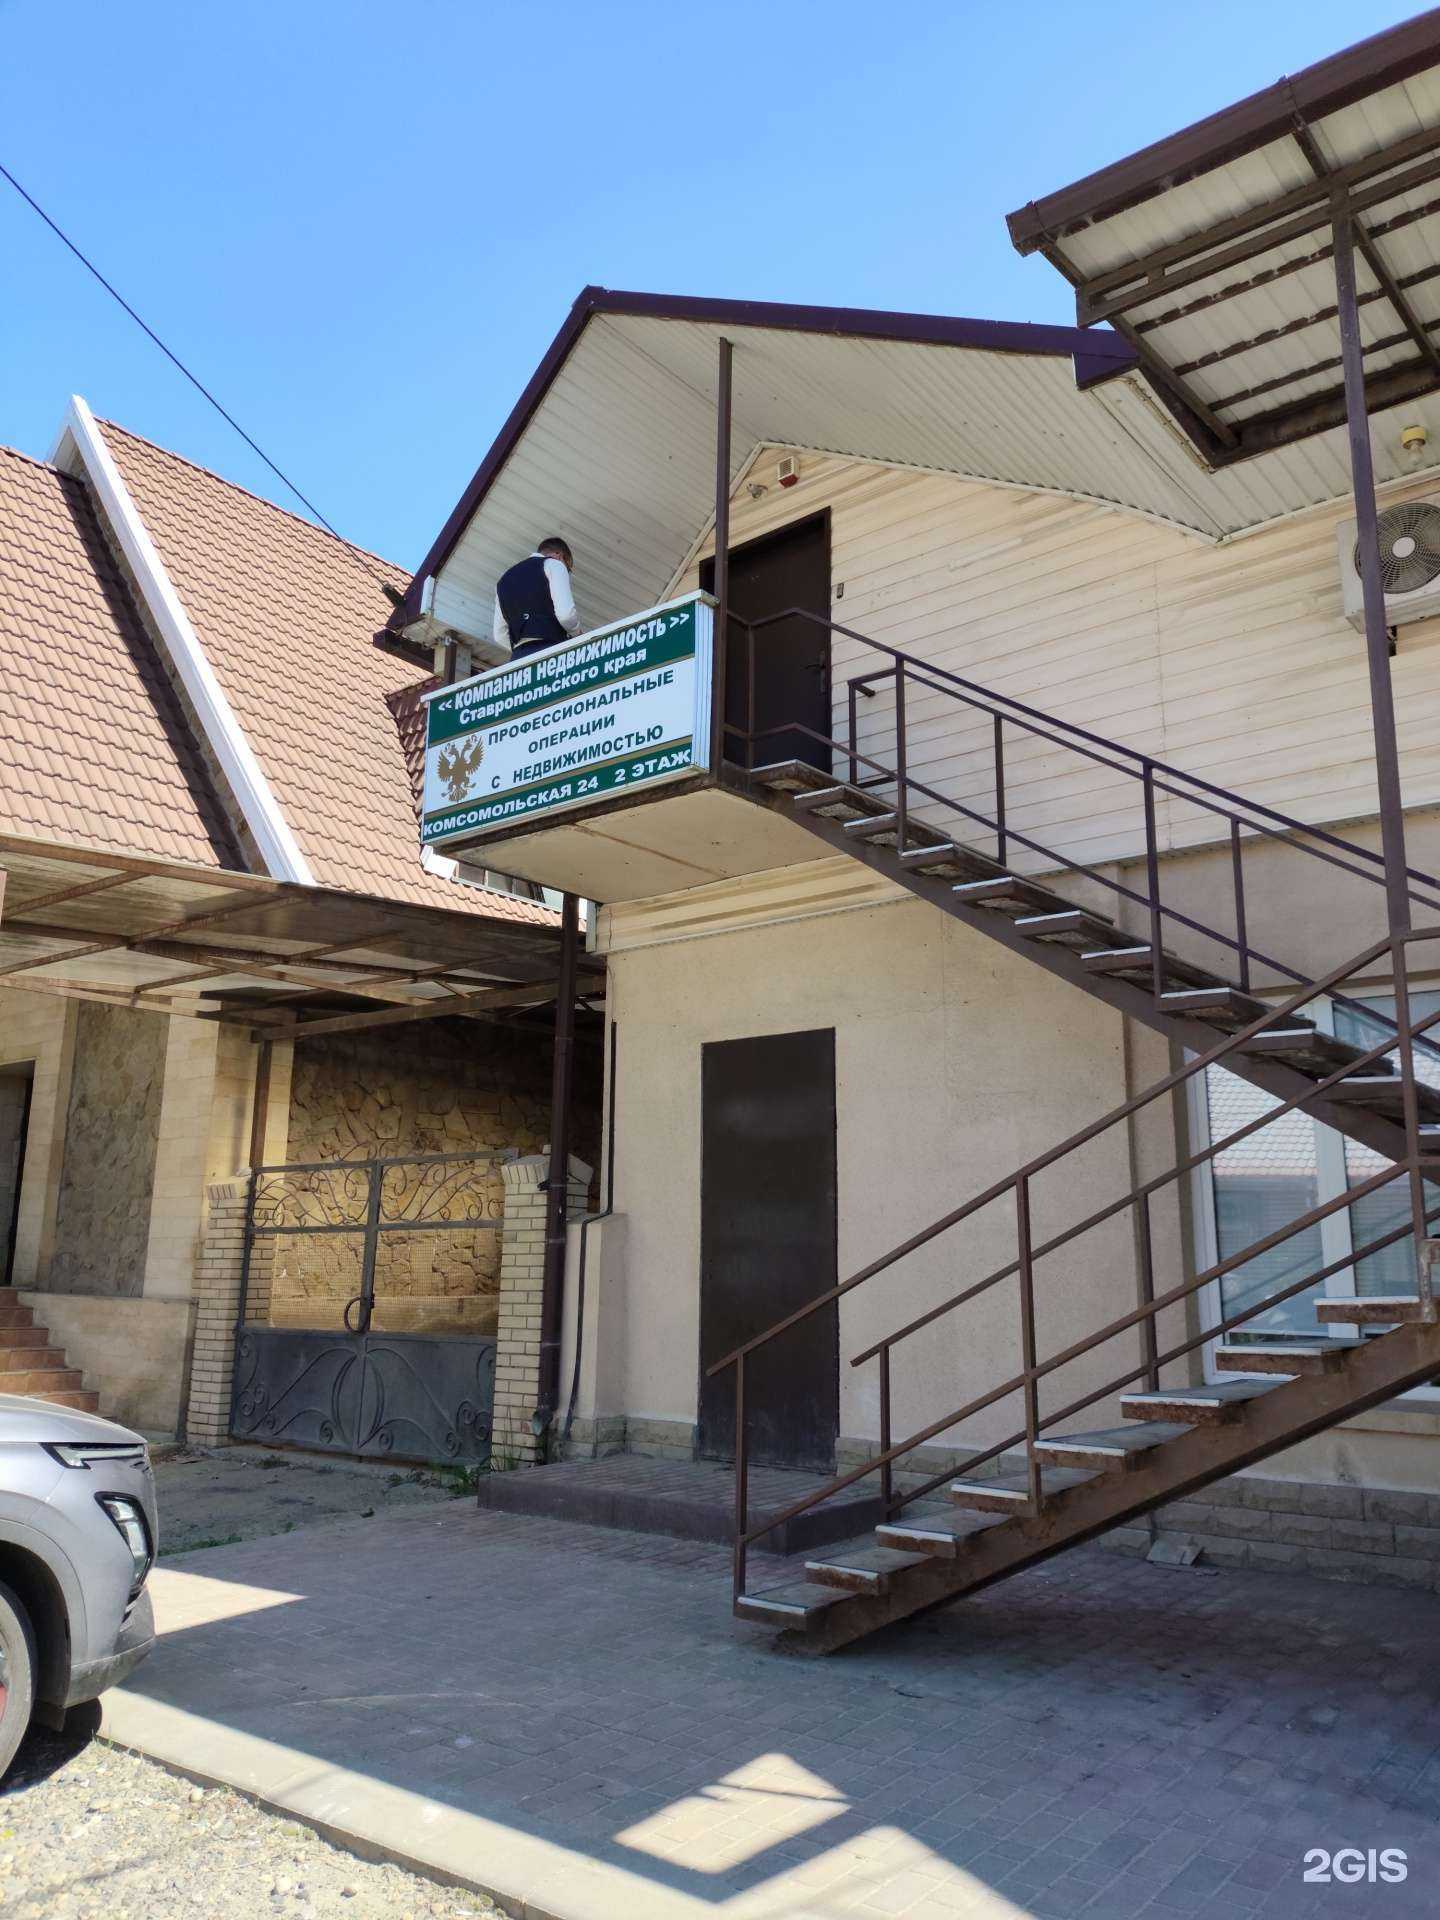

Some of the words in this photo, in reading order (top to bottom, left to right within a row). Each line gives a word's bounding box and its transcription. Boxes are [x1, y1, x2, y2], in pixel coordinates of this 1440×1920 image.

[459, 666, 599, 725] Ставропольского
[603, 648, 647, 674] края
[488, 669, 674, 745] ПРОФЕССИОНАЛЬНЫЕ
[491, 775, 500, 790] С
[513, 725, 663, 784] НЕДВИЖИМОСТЬЮ
[528, 714, 615, 754] ОПЕРАЦИИ
[423, 783, 572, 836] КОМСОМОЛЬСКАЯ
[577, 775, 599, 792] 24
[614, 768, 626, 783] 2
[631, 748, 691, 778] ЭТАЖ
